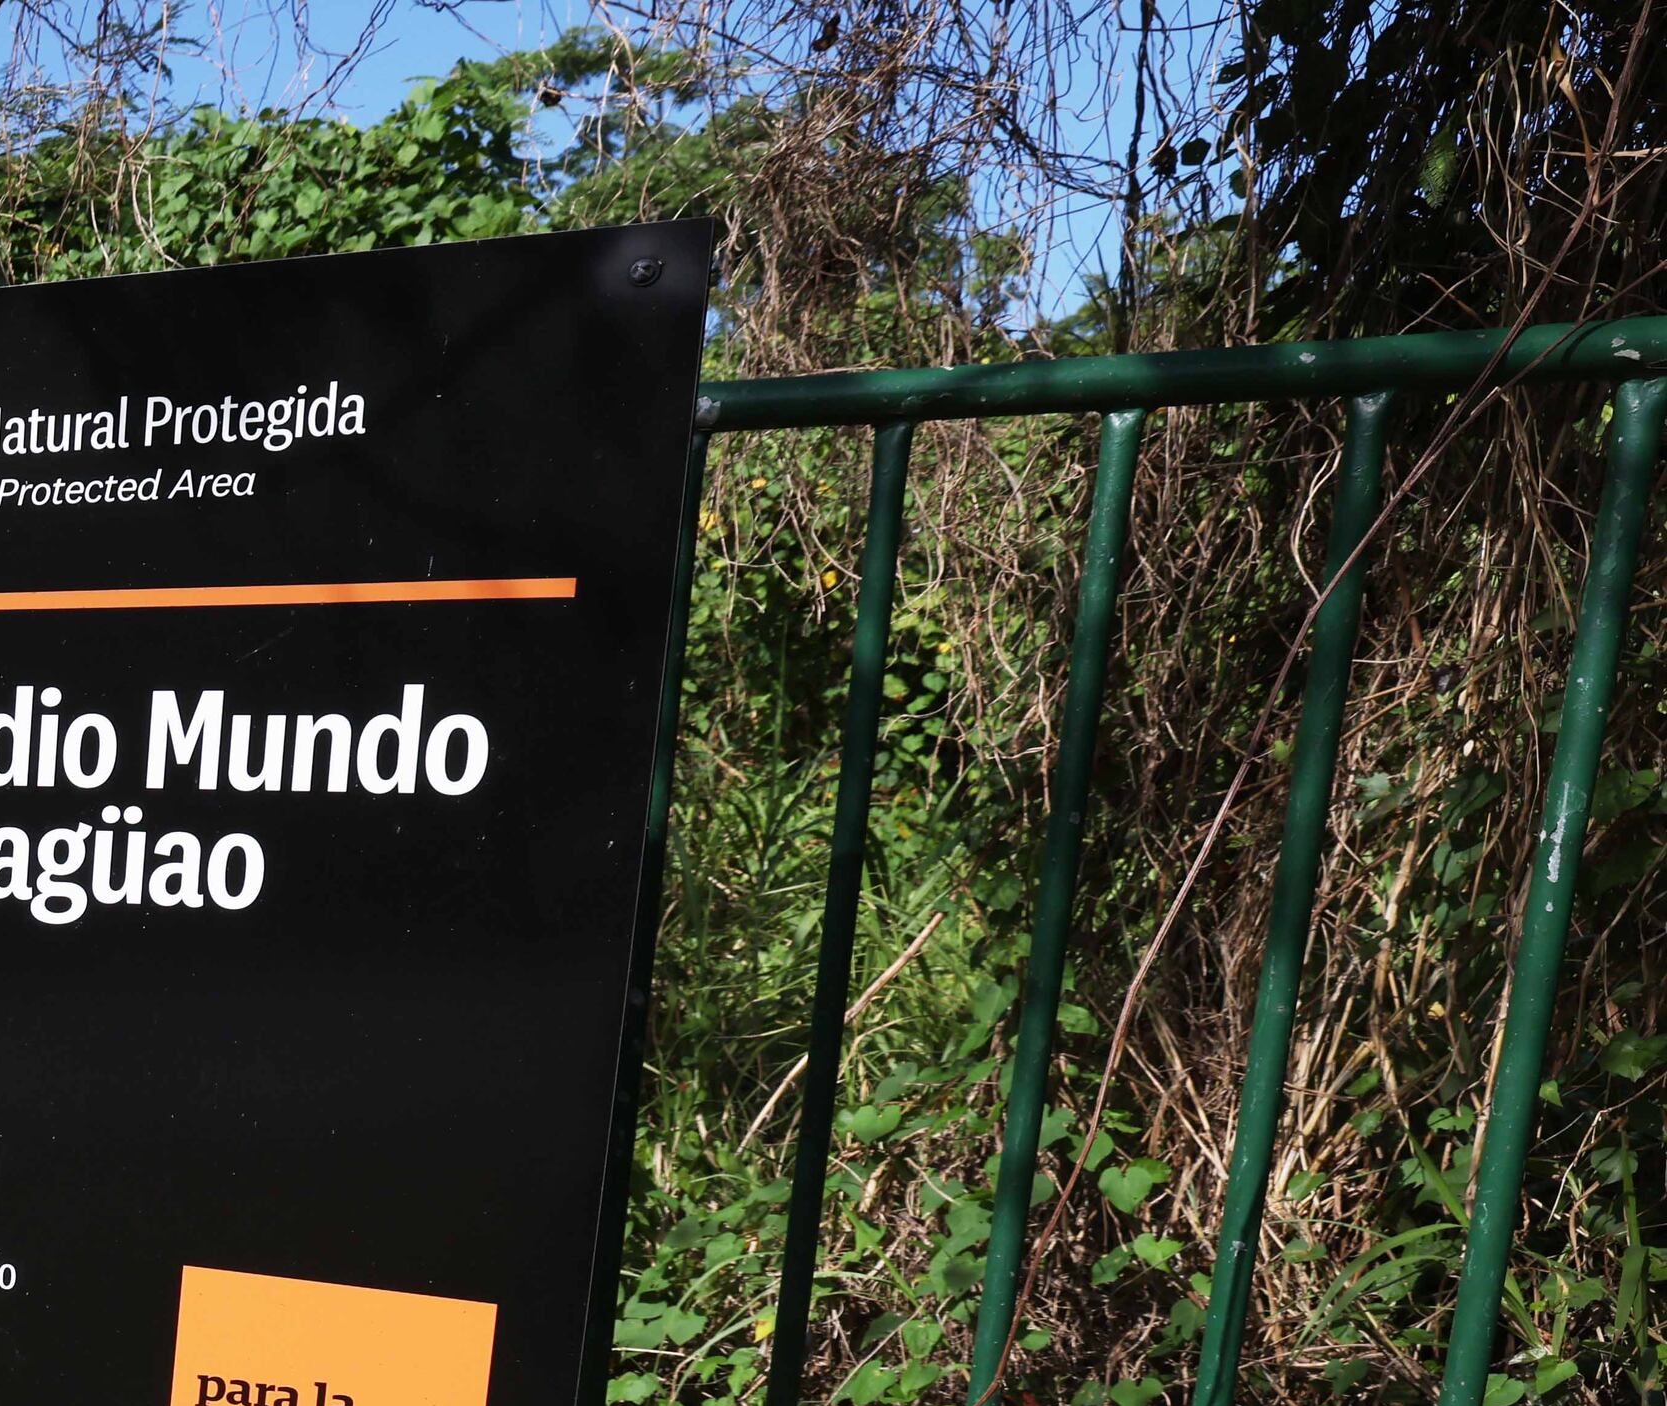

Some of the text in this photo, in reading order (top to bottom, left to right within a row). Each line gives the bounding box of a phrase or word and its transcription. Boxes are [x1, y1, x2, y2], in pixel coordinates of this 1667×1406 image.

[144, 380, 366, 452] Protegida
[167, 469, 256, 500] Area
[145, 683, 489, 796] Mundo
